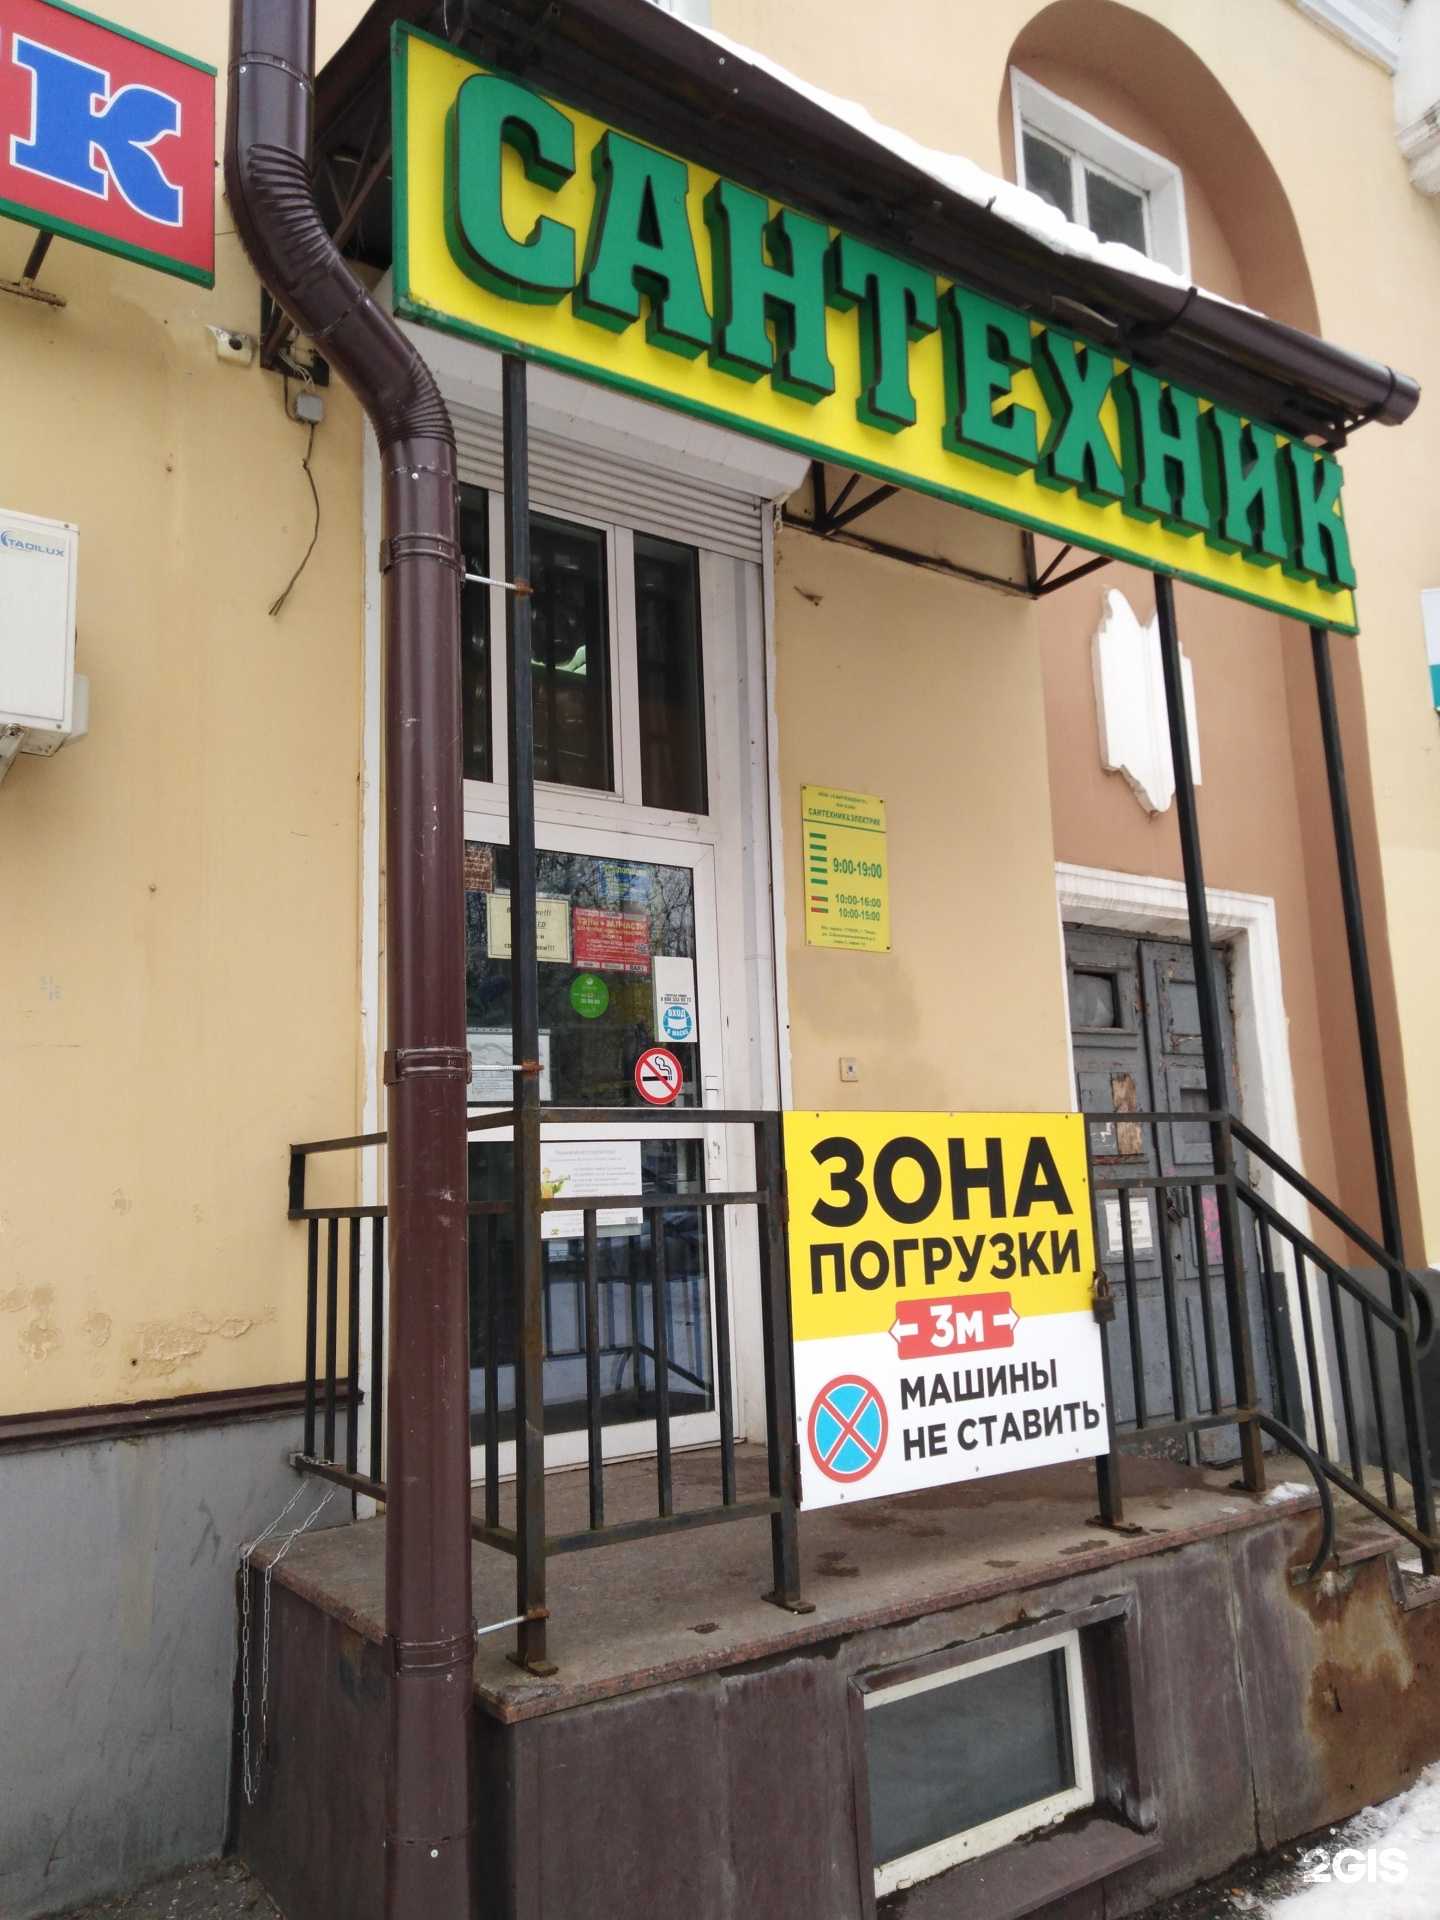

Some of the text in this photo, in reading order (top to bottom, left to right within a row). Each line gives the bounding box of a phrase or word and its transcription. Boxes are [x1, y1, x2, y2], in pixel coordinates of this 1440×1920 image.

[444, 72, 1357, 592] САНТЕХНИК
[833, 857, 882, 879] 9:00-19:00
[810, 1136, 1074, 1228] ЗОНА
[809, 1229, 1082, 1295] ПОГРУЗКИ
[899, 1358, 1058, 1411] МАШИНЫ
[902, 1400, 1101, 1462] НЕ СТАВИТЬ
